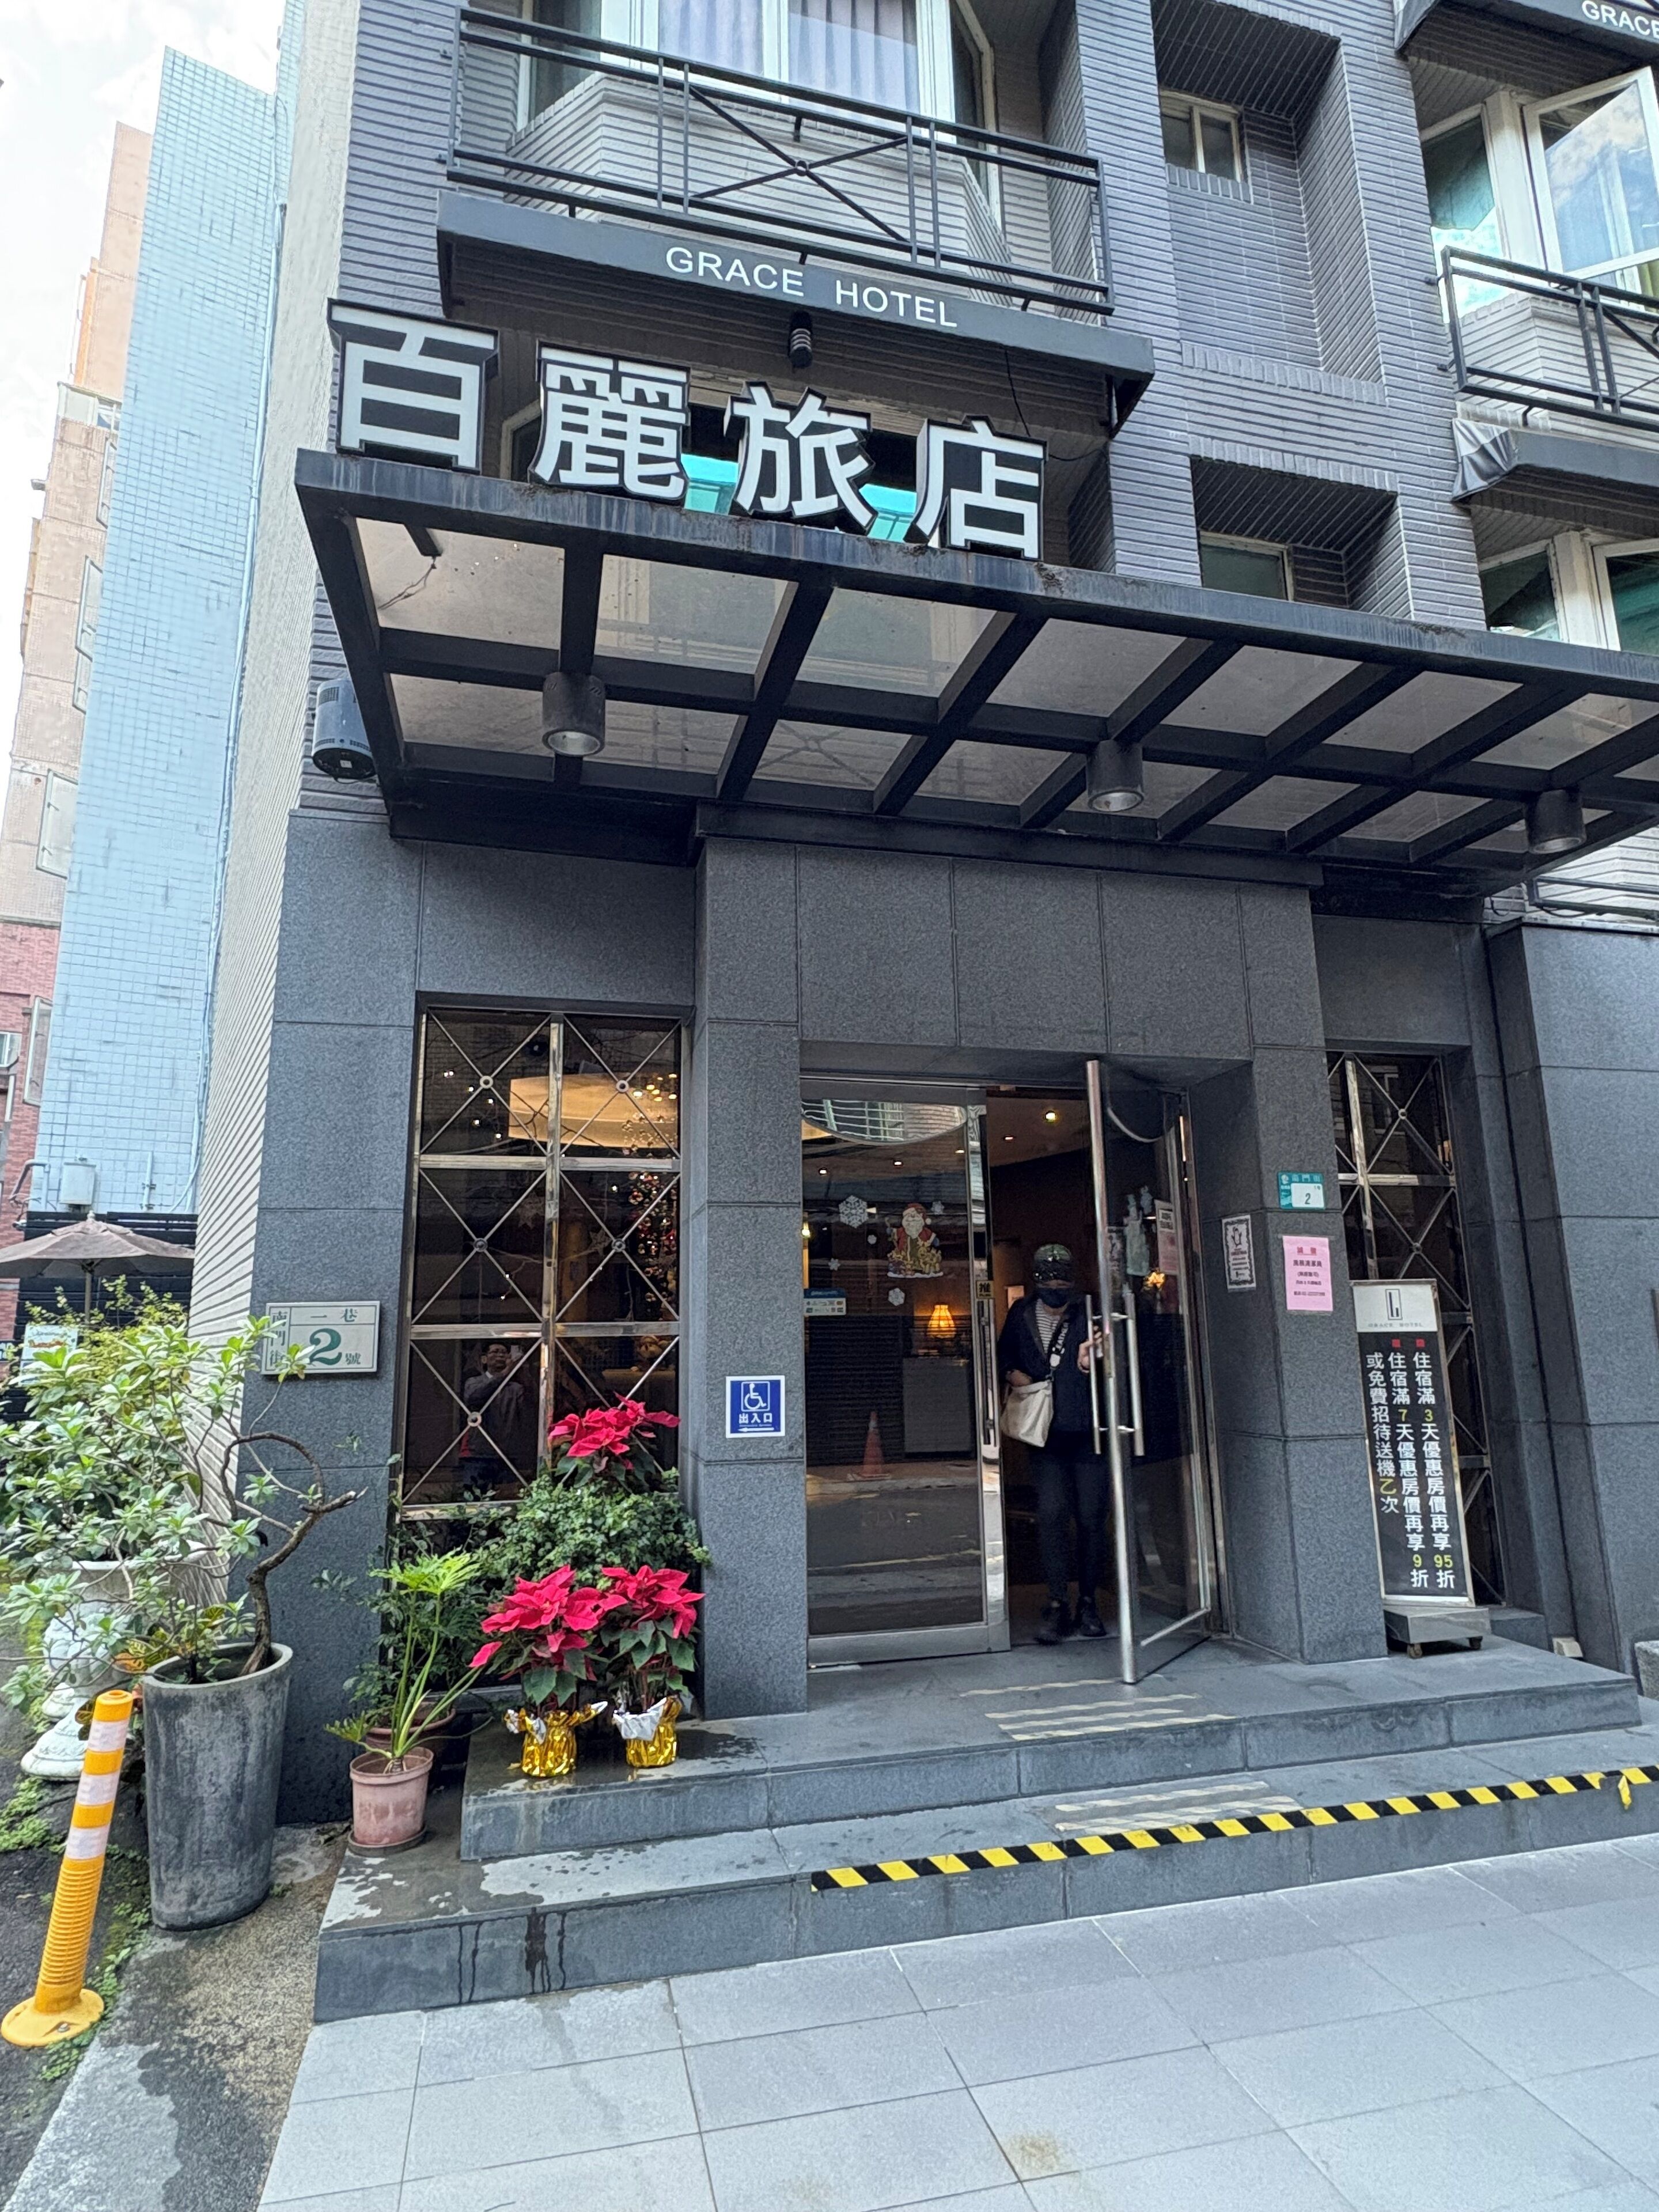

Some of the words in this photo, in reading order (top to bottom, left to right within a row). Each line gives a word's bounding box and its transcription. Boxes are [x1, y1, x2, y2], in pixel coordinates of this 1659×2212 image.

[665, 245, 805, 297] GRACE
[834, 278, 957, 328] HOTEL
[331, 301, 1046, 560] 百麗旅店
[1304, 1192, 1311, 1205] 2
[738, 1412, 772, 1425] 出入口
[1366, 1351, 1400, 1514] 或免費招待送機乙次
